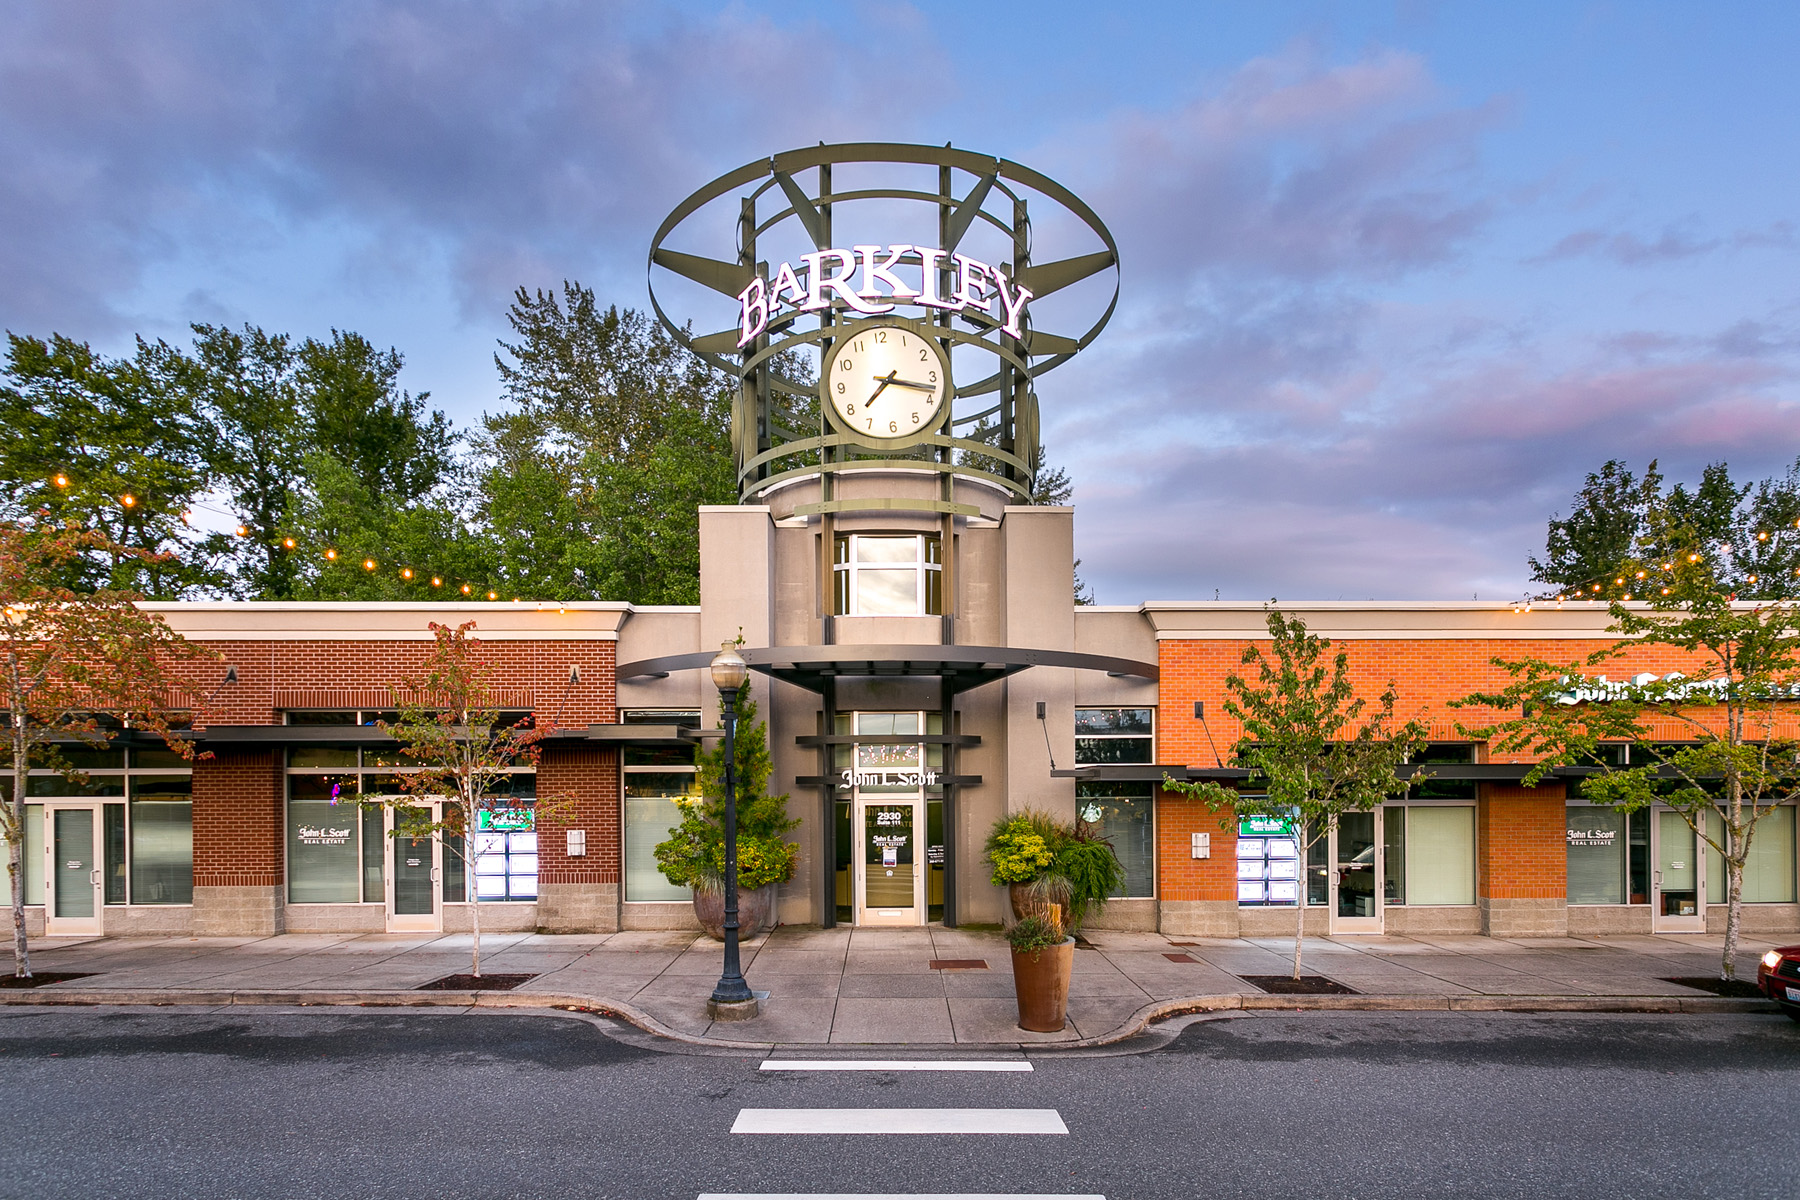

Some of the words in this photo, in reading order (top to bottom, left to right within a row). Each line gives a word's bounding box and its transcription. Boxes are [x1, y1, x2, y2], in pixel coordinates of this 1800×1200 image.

[737, 244, 1034, 349] BARKLEY
[874, 331, 887, 344] 12
[902, 335, 906, 347] 1
[854, 340, 864, 352] 11
[919, 349, 928, 361] 2
[839, 359, 852, 371] 10
[929, 371, 937, 382] 3
[837, 382, 845, 394] 9
[926, 394, 934, 405] 4
[847, 403, 855, 416] 8
[865, 418, 873, 430] 7
[911, 412, 920, 424] 5
[889, 420, 897, 433] 6
[840, 770, 877, 788] John
[882, 772, 896, 786] L.
[896, 772, 936, 786] Scott
[877, 812, 901, 820] 2930
[298, 828, 319, 838] John
[329, 828, 349, 837] Scott
[1566, 830, 1586, 839] John
[1595, 830, 1614, 838] Scott
